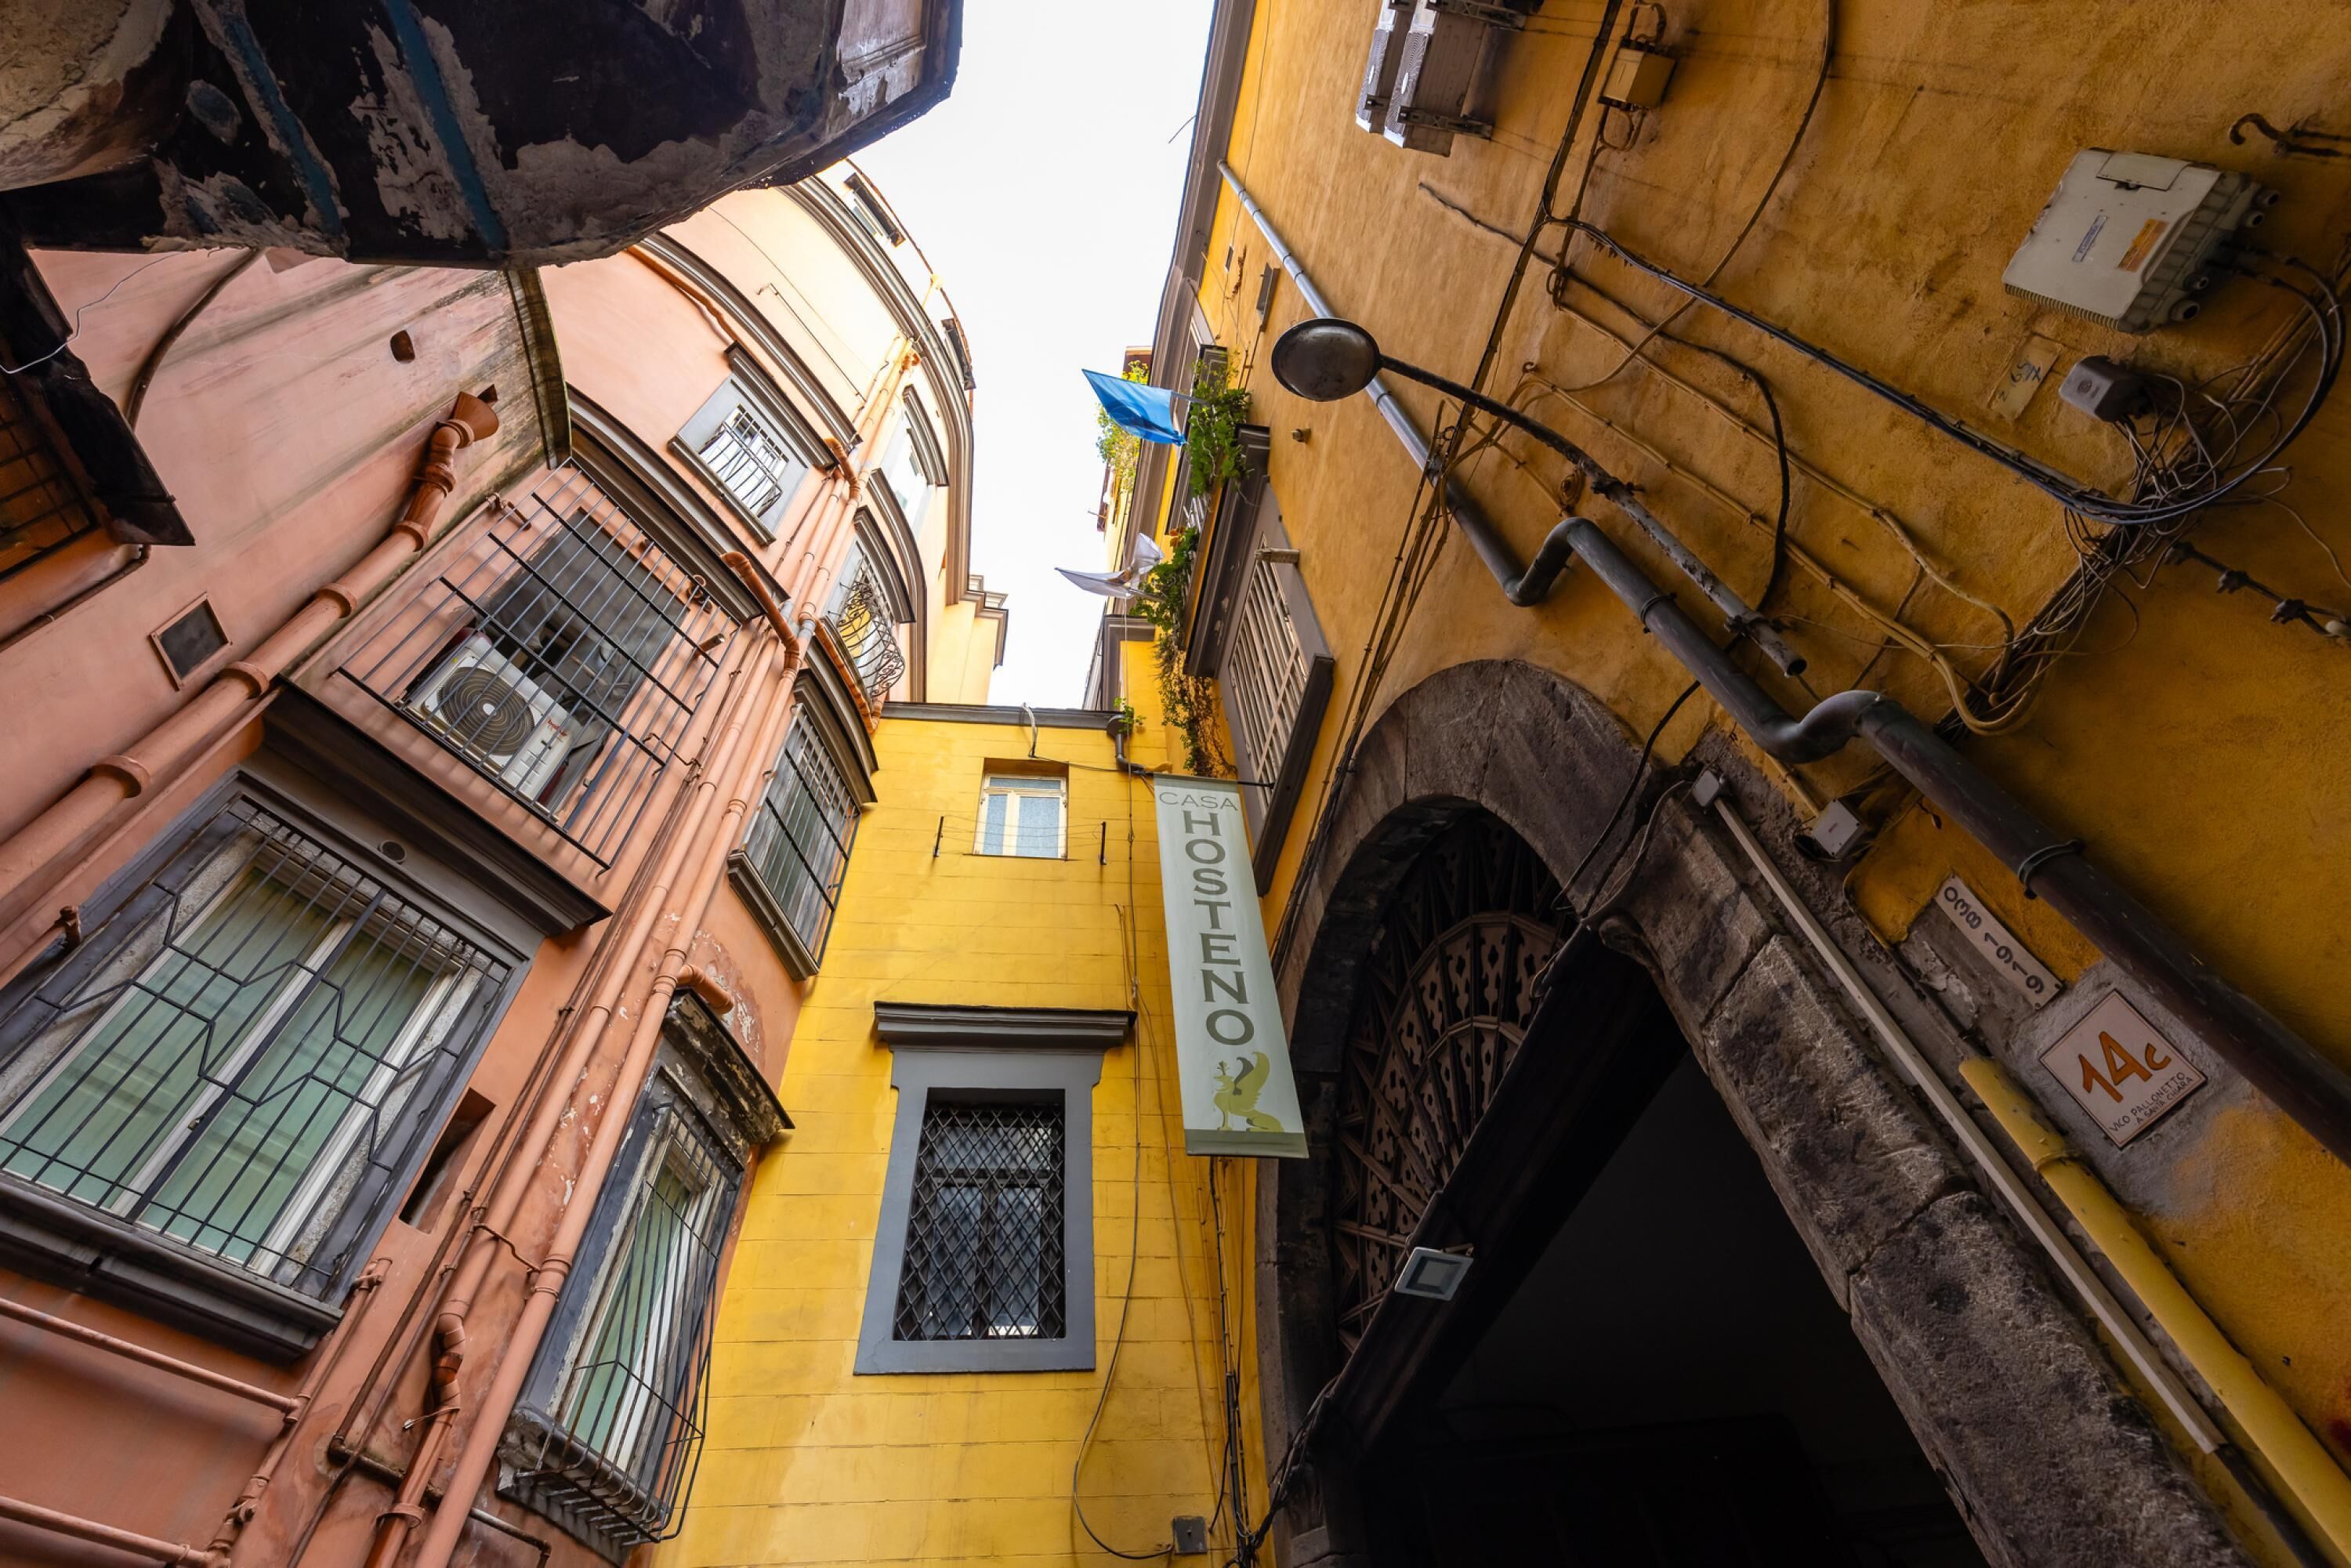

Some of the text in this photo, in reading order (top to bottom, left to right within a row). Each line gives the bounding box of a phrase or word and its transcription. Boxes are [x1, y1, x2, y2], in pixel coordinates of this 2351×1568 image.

[1159, 791, 1239, 811] CASA
[1182, 810, 1255, 1046] HOSTENO
[1944, 886, 1982, 929] 038
[2108, 1071, 2186, 1132] VICO PALLONETTO
[2143, 1100, 2166, 1118] SANTA
[2167, 1077, 2193, 1101] CHIARA
